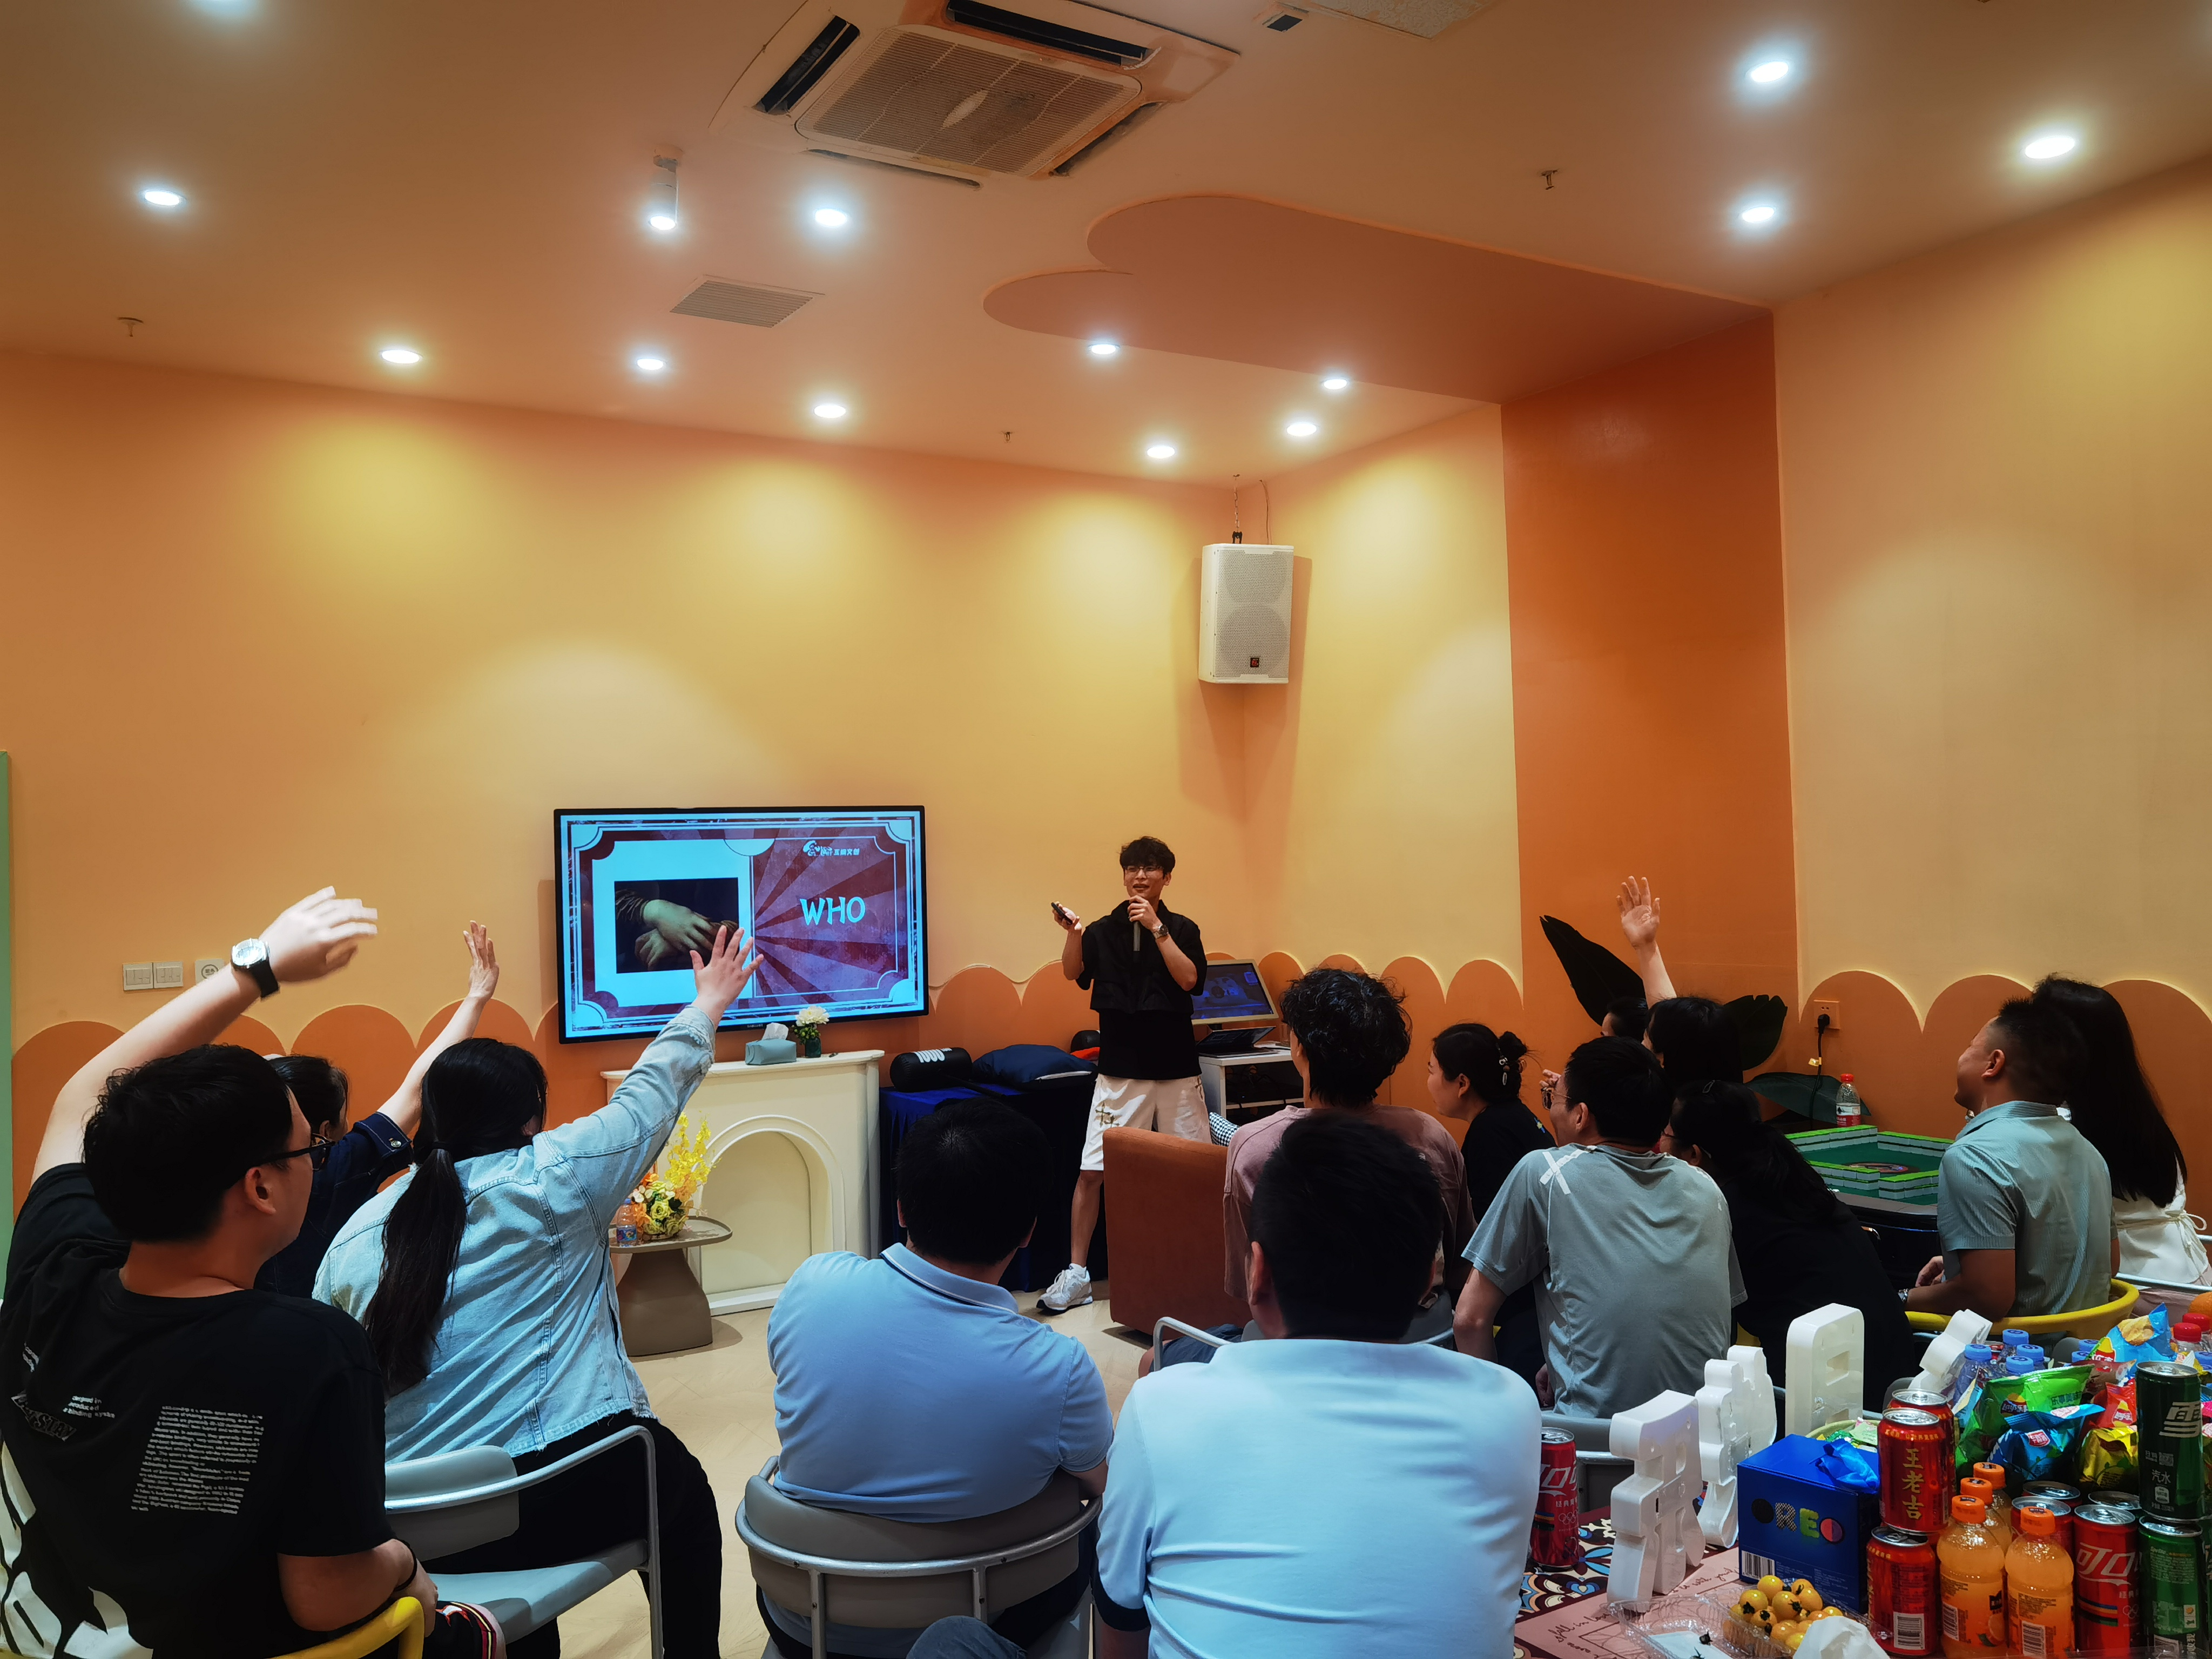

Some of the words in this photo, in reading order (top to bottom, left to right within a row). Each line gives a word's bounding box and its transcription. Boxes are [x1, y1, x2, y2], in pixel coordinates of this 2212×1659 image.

[799, 896, 865, 925] WHO
[1901, 1448, 1924, 1520] 王老吉
[2152, 1469, 2170, 1485] 汽水
[1751, 1498, 1845, 1545] OREO
[2076, 1542, 2142, 1577] 可口
